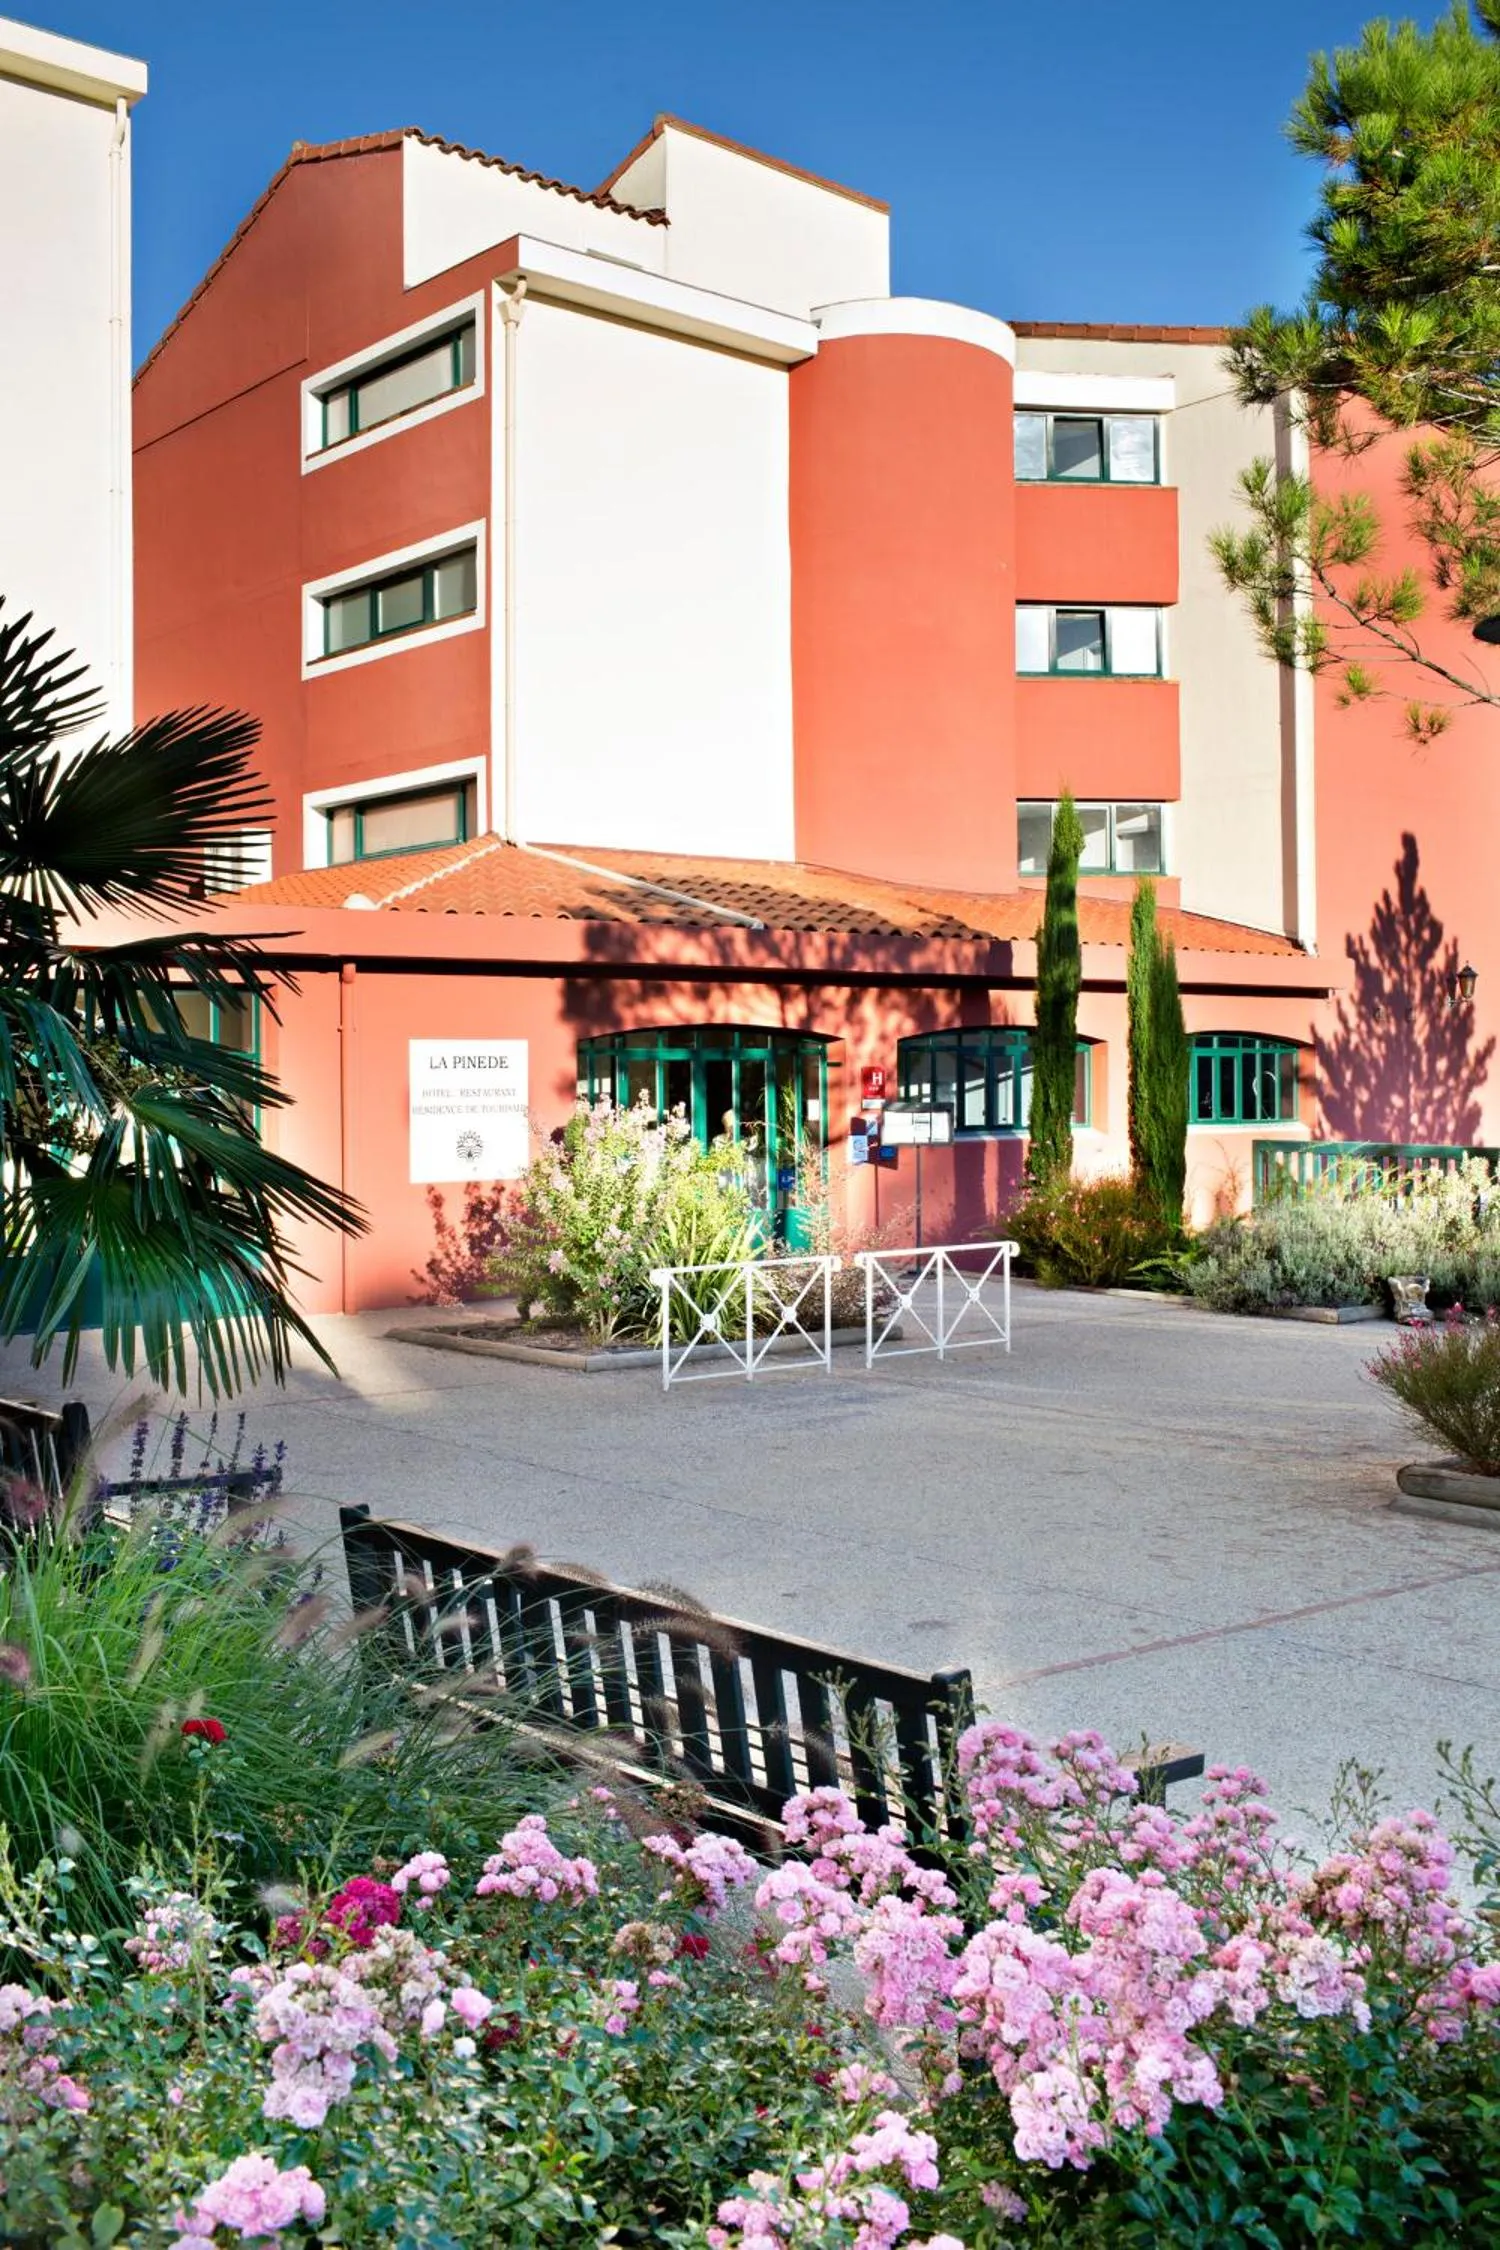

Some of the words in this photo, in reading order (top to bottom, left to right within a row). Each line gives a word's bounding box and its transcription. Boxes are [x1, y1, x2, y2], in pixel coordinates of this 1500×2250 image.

[429, 1056, 448, 1069] LA
[452, 1055, 509, 1069] PINEDE
[872, 1071, 883, 1086] H
[459, 1088, 516, 1098] RESTAURANT
